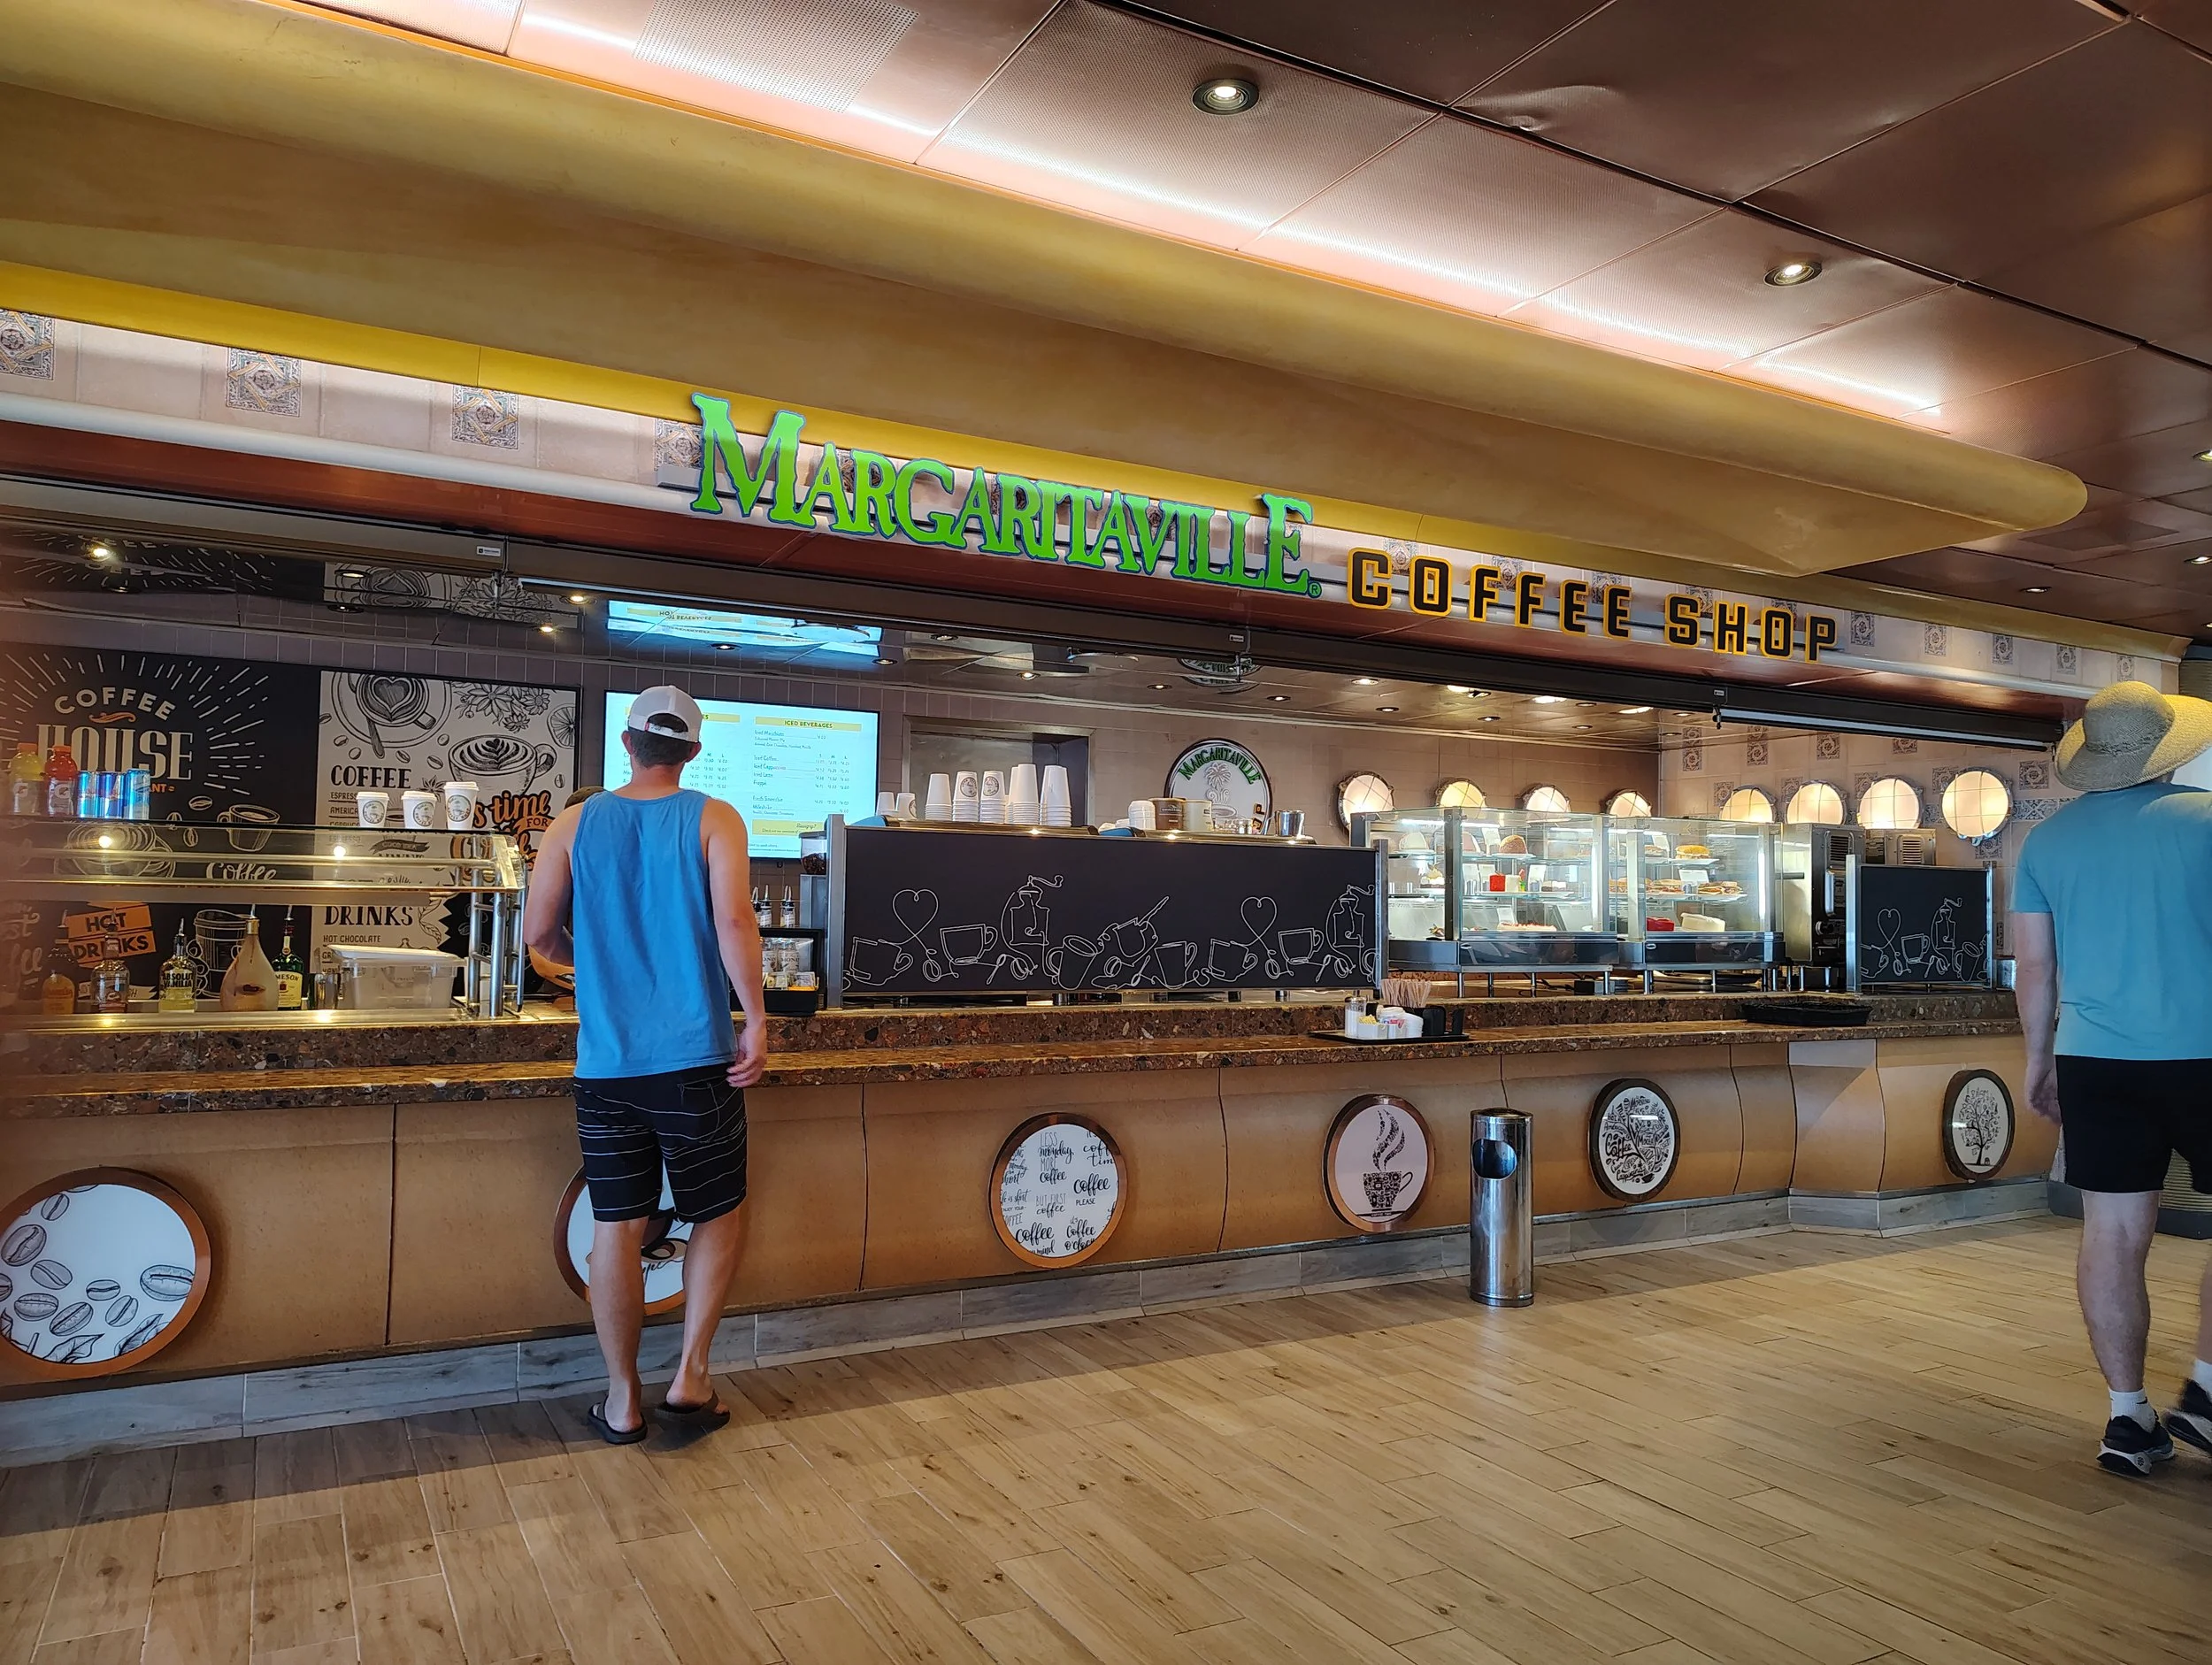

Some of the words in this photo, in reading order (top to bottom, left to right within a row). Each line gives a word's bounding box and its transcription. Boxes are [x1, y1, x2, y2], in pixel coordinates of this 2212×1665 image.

[1347, 547, 1632, 639] COFFEE
[1663, 592, 1838, 664] SHOP
[54, 687, 176, 721] COFFEE
[36, 724, 194, 780] HOUSE
[330, 764, 412, 789] COFFEE
[1177, 747, 1262, 786] MARGARITAVILLE
[330, 792, 357, 801] ESPRESS
[330, 806, 358, 815] AMERICA
[489, 789, 551, 825] time
[526, 817, 549, 828] FOR
[85, 912, 127, 932] HOT
[324, 906, 413, 926] DRINKS
[323, 934, 338, 943] HOT
[340, 934, 381, 943] CHOCOLATE
[1040, 1132, 1058, 1147] LESS
[1087, 1153, 1114, 1167] tim
